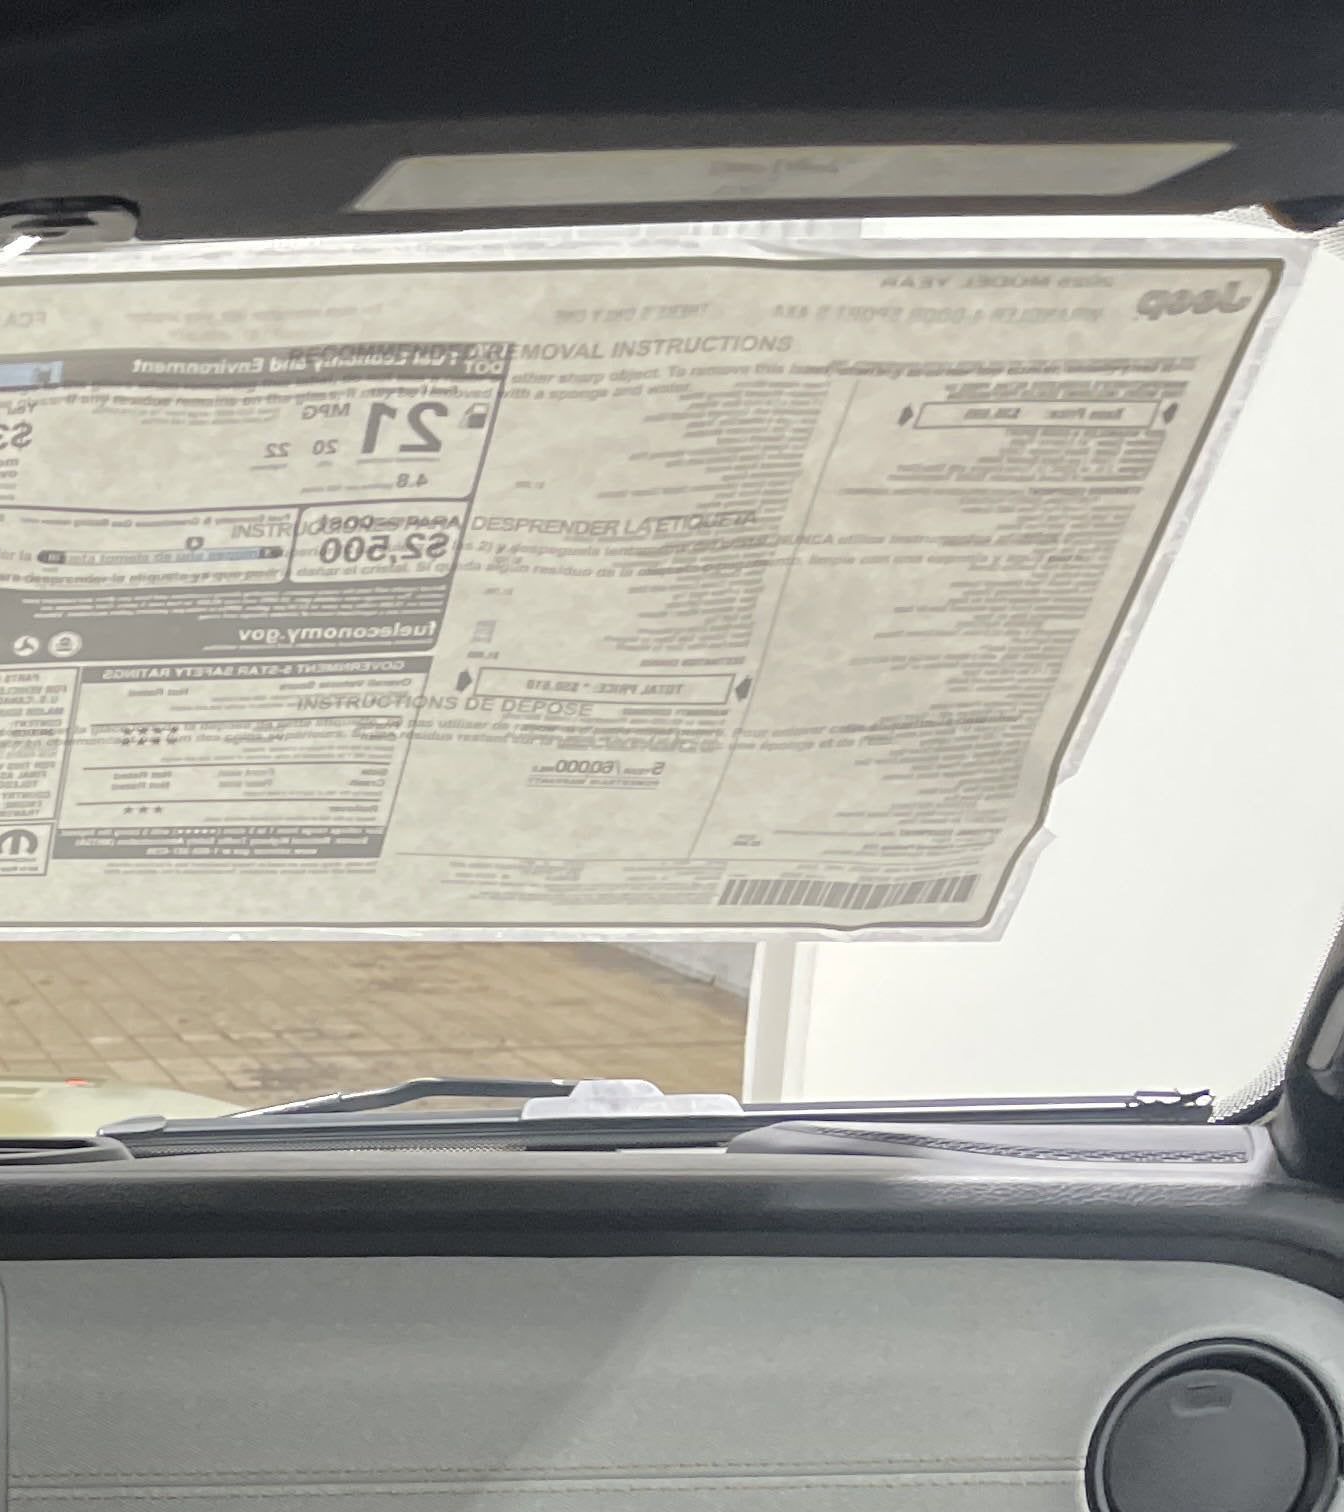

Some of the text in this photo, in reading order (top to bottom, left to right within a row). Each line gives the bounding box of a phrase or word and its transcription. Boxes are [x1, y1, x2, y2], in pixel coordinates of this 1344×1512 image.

[611, 335, 794, 357] INSTRUCTIONS
[470, 516, 620, 535] DESPRENDER
[624, 517, 651, 536] LA
[297, 696, 457, 712] INSTRUCTIONS
[464, 697, 493, 712] DE
